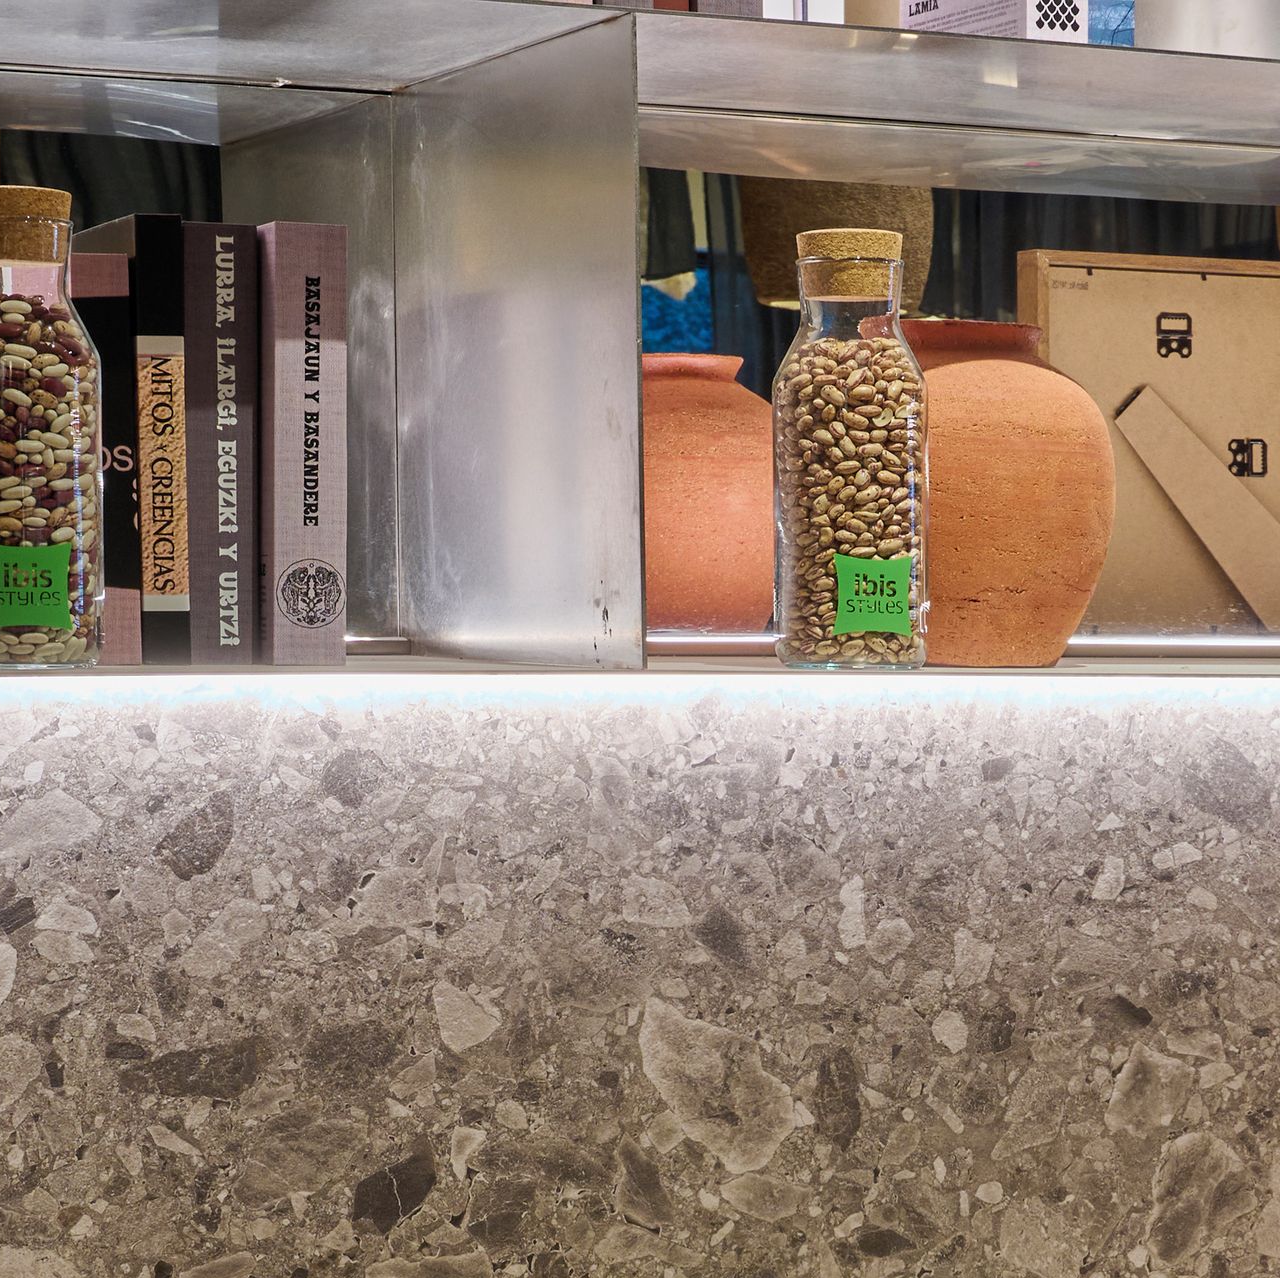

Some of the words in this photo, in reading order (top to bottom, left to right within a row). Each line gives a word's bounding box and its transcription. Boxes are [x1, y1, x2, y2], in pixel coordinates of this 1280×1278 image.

[215, 235, 235, 328] LURRA,
[305, 275, 321, 382] BASAJAUN
[151, 356, 175, 436] MITOS
[304, 389, 320, 401] Y
[303, 410, 320, 527] BASANDERE
[151, 457, 176, 591] CREENCIAS
[218, 543, 238, 561] Y
[3, 562, 53, 588] ibis
[854, 573, 897, 598] ibis
